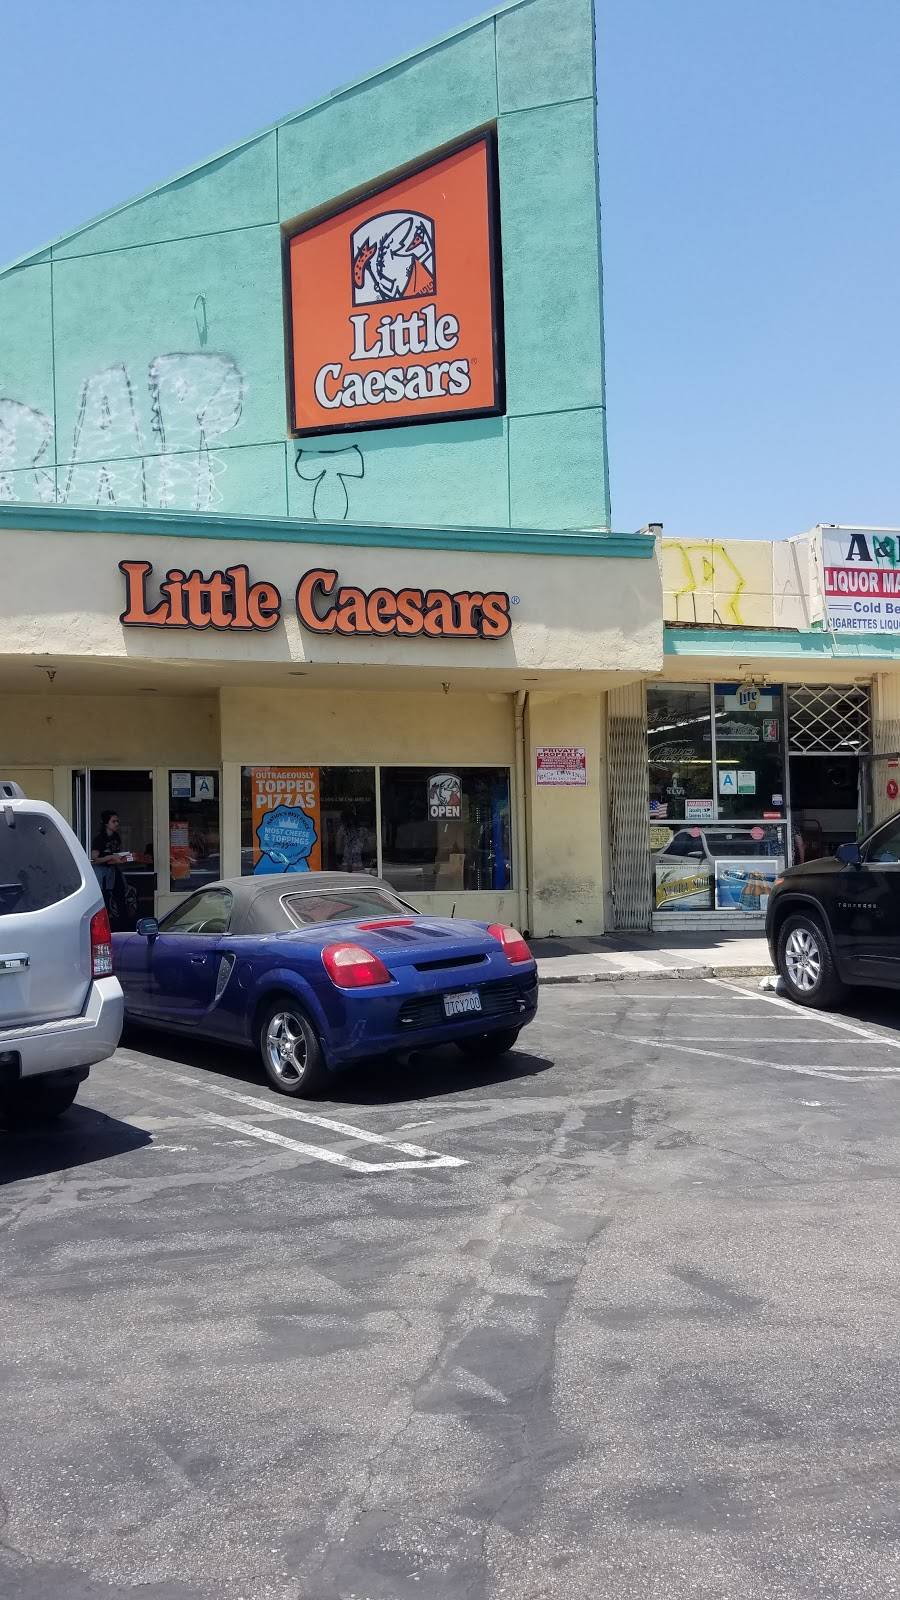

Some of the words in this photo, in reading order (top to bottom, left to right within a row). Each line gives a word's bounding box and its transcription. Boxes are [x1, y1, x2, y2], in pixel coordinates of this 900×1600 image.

[349, 303, 460, 361] Little
[314, 358, 471, 409] Caesars
[824, 570, 880, 593] LIQUOR
[118, 560, 282, 632] Little
[296, 568, 513, 640] Caesars
[853, 601, 881, 613] Cold
[256, 771, 314, 779] OUTRAGEOUSLY
[724, 774, 733, 785] A
[200, 780, 209, 792] A
[256, 780, 315, 793] TOPPED
[256, 794, 316, 809] PIZZAS
[430, 806, 460, 818] OPEN
[265, 827, 283, 835] MOST
[285, 830, 310, 838] CHEESE
[272, 835, 309, 845] TOPPINGS
